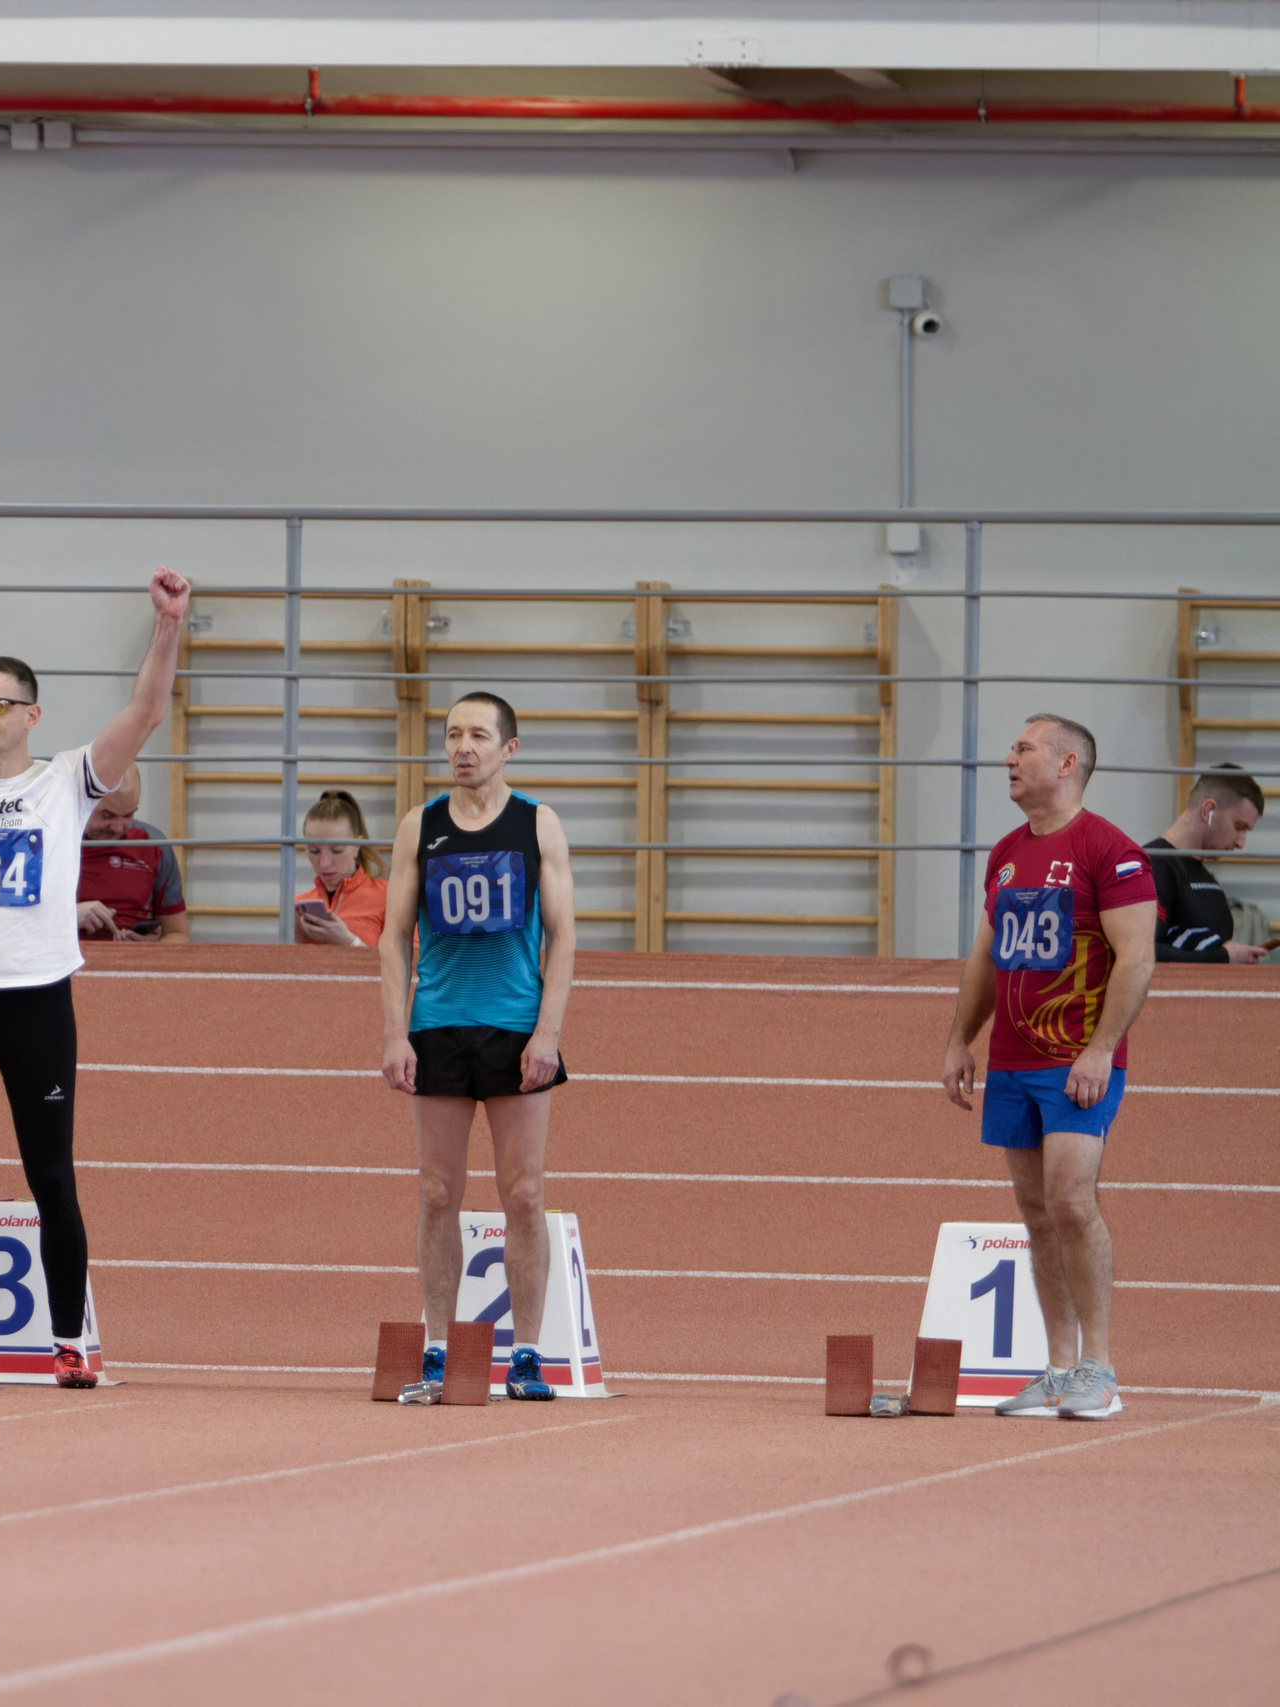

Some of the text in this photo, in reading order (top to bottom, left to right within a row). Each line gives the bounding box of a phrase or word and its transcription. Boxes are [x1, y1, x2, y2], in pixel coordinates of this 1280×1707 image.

[0, 818, 23, 828] Team
[440, 872, 512, 925] 091
[1000, 910, 1060, 960] 043
[982, 1237, 1032, 1251] polani
[571, 1246, 592, 1347] 2
[970, 1259, 1016, 1358] 1
